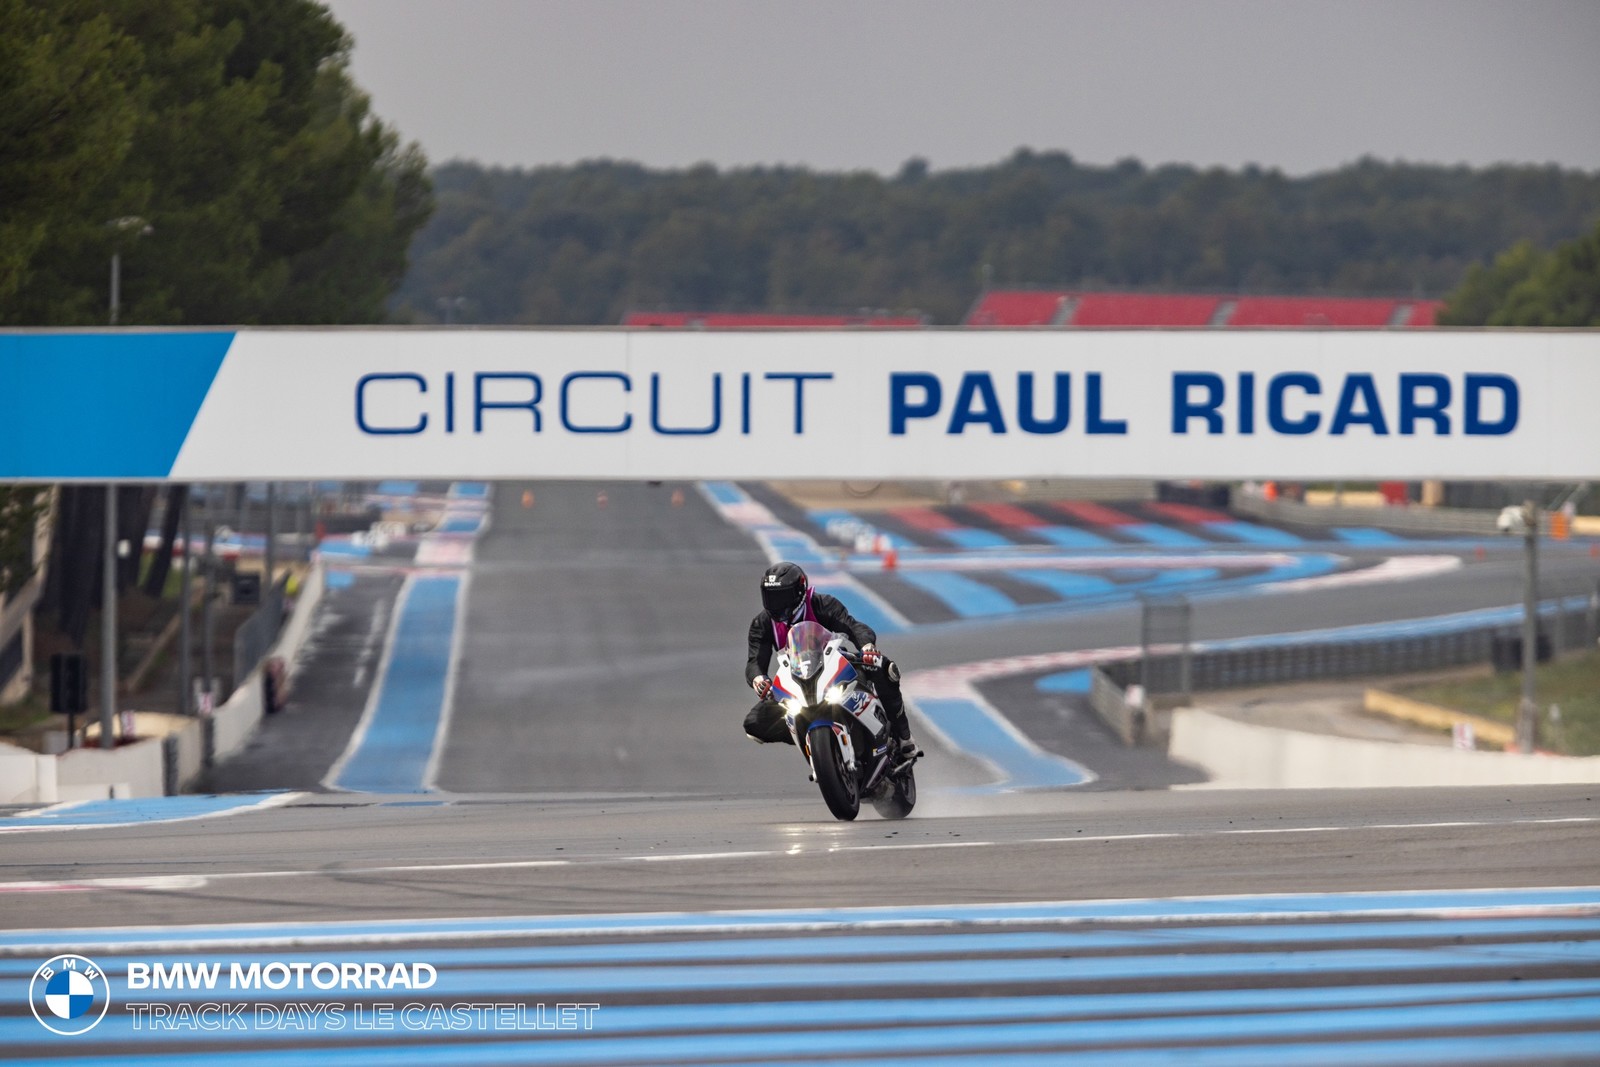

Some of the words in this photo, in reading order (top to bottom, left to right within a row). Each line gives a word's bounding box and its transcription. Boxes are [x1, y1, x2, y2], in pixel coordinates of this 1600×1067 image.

[354, 371, 834, 436] CIRCUIT
[888, 371, 1129, 436] PAUL
[1170, 371, 1521, 437] RICARD
